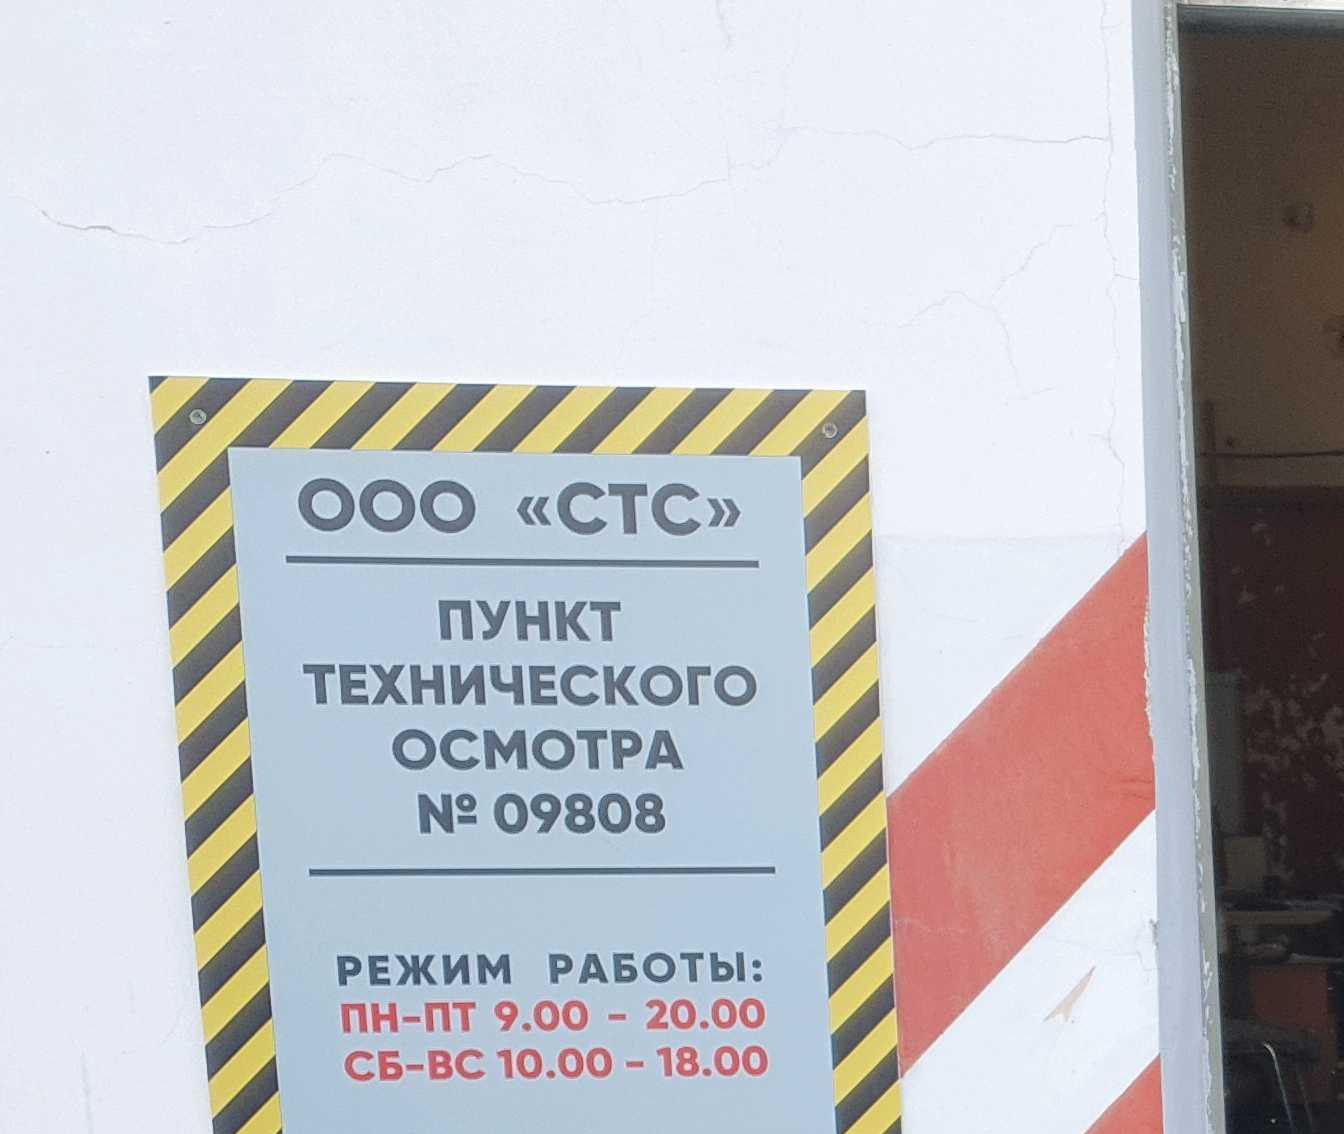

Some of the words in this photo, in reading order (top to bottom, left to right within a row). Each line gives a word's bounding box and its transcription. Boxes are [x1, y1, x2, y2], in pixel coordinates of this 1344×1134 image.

[297, 477, 476, 534] ООО
[516, 482, 741, 536] «СТС»
[438, 599, 622, 642] ПУНКТ
[302, 663, 757, 707] ТЕХНИЧЕСКОГО
[391, 728, 684, 771] ОСМОТРА
[417, 793, 478, 834] №
[493, 792, 666, 835] 09808
[336, 953, 512, 987] РЕЖИМ
[548, 951, 763, 985] РАБОТЫ:
[341, 1001, 477, 1034] ПН-ПТ
[495, 1000, 591, 1033] 9.00
[646, 997, 767, 1032] 20.00
[344, 1049, 485, 1083] СБ-ВС
[496, 1047, 614, 1080] 10.00
[657, 1045, 769, 1078] 18.00
